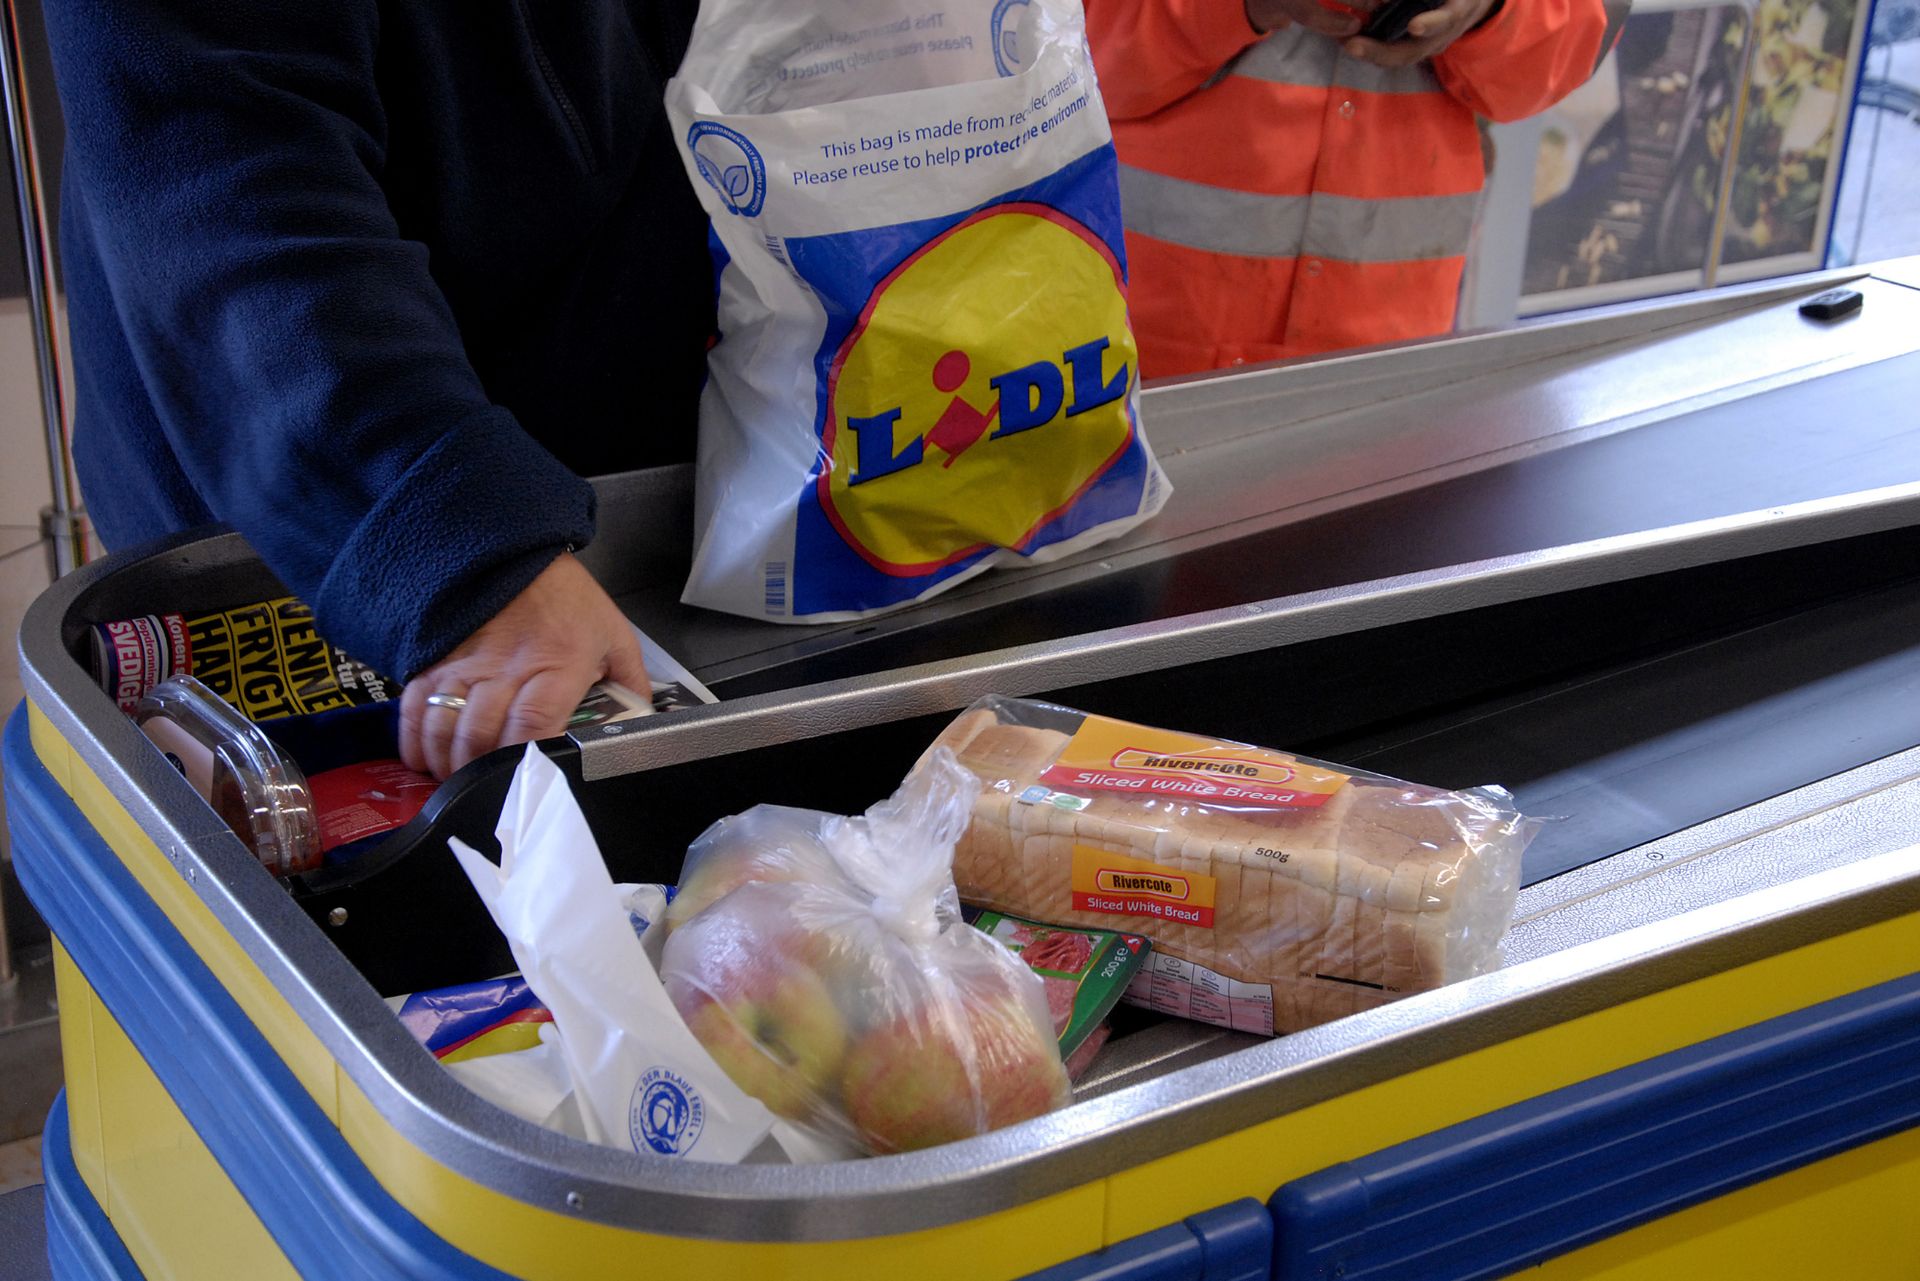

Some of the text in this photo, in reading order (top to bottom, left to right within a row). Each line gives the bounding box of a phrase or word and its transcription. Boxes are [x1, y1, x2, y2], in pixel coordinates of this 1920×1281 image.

[821, 142, 856, 158] This
[860, 135, 893, 151] bag
[898, 130, 911, 143] is
[915, 120, 963, 141] made
[967, 116, 1005, 133] from
[793, 167, 848, 185] Please
[852, 158, 899, 177] reuse
[903, 146, 921, 170] to
[925, 147, 960, 166] help
[964, 135, 1020, 164] protect
[166, 615, 186, 665] Konen
[230, 605, 297, 720] FRYGT
[360, 669, 392, 703] efter
[1143, 755, 1259, 778] Rivercote
[1073, 772, 1295, 803] Sliced White Bread
[1254, 847, 1290, 864] 500g
[1112, 874, 1172, 893] Rivercote
[1087, 897, 1200, 922] Sliced White Bread
[642, 1070, 702, 1127] DER BLAUE ENGEL
